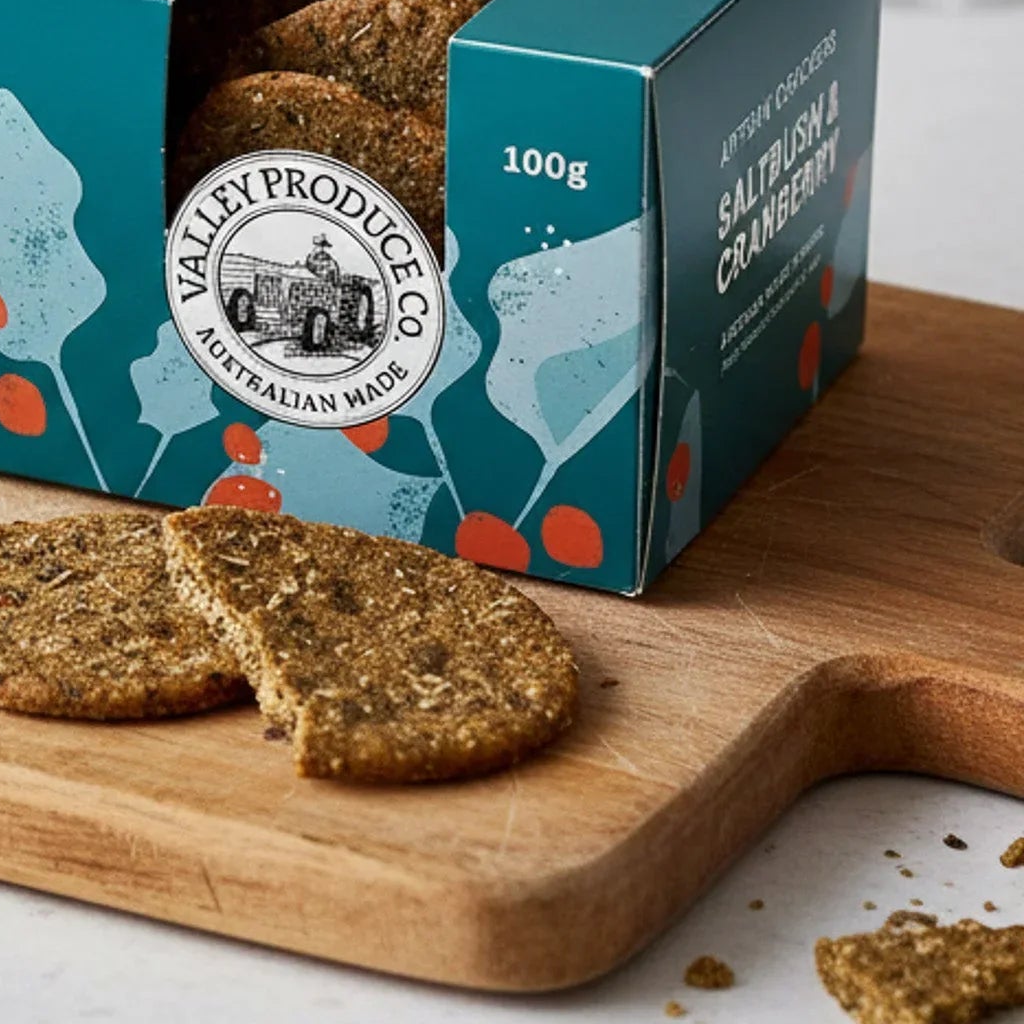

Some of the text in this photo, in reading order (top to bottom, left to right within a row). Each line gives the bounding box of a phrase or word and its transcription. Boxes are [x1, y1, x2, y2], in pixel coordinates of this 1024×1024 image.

[503, 145, 588, 190] 100g
[178, 167, 429, 342] VALLEY PRODUCE CO.
[343, 360, 409, 409] MADE
